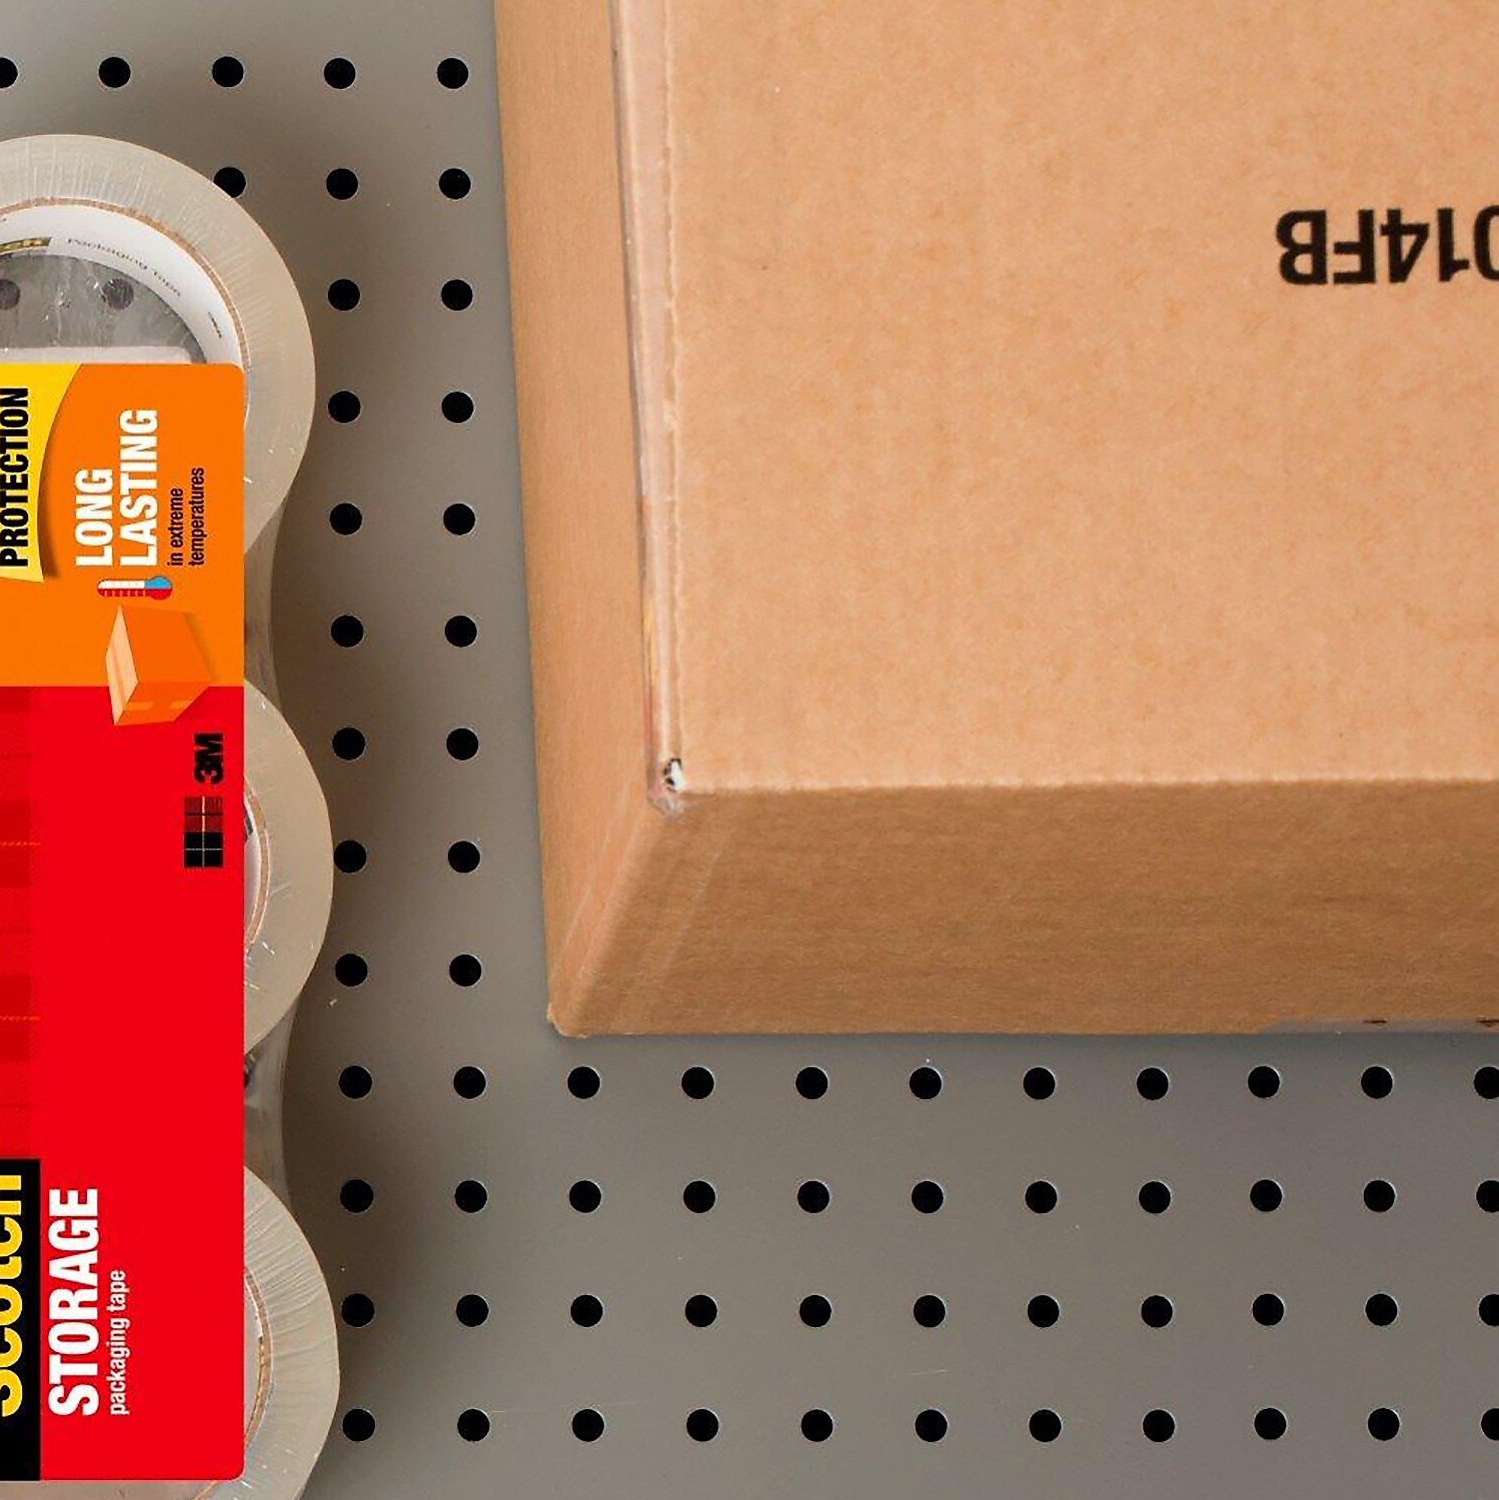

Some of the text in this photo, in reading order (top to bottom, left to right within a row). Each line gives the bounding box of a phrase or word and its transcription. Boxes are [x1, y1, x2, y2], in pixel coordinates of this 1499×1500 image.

[0, 388, 29, 567] PROTECTION
[75, 469, 113, 566] LONG
[120, 410, 158, 566] LASTING
[167, 488, 184, 566] in extreme
[188, 467, 207, 566] temperatures
[193, 733, 224, 785] 3M
[48, 1188, 99, 1416] STORAGE
[106, 1269, 130, 1416] packaging tape
